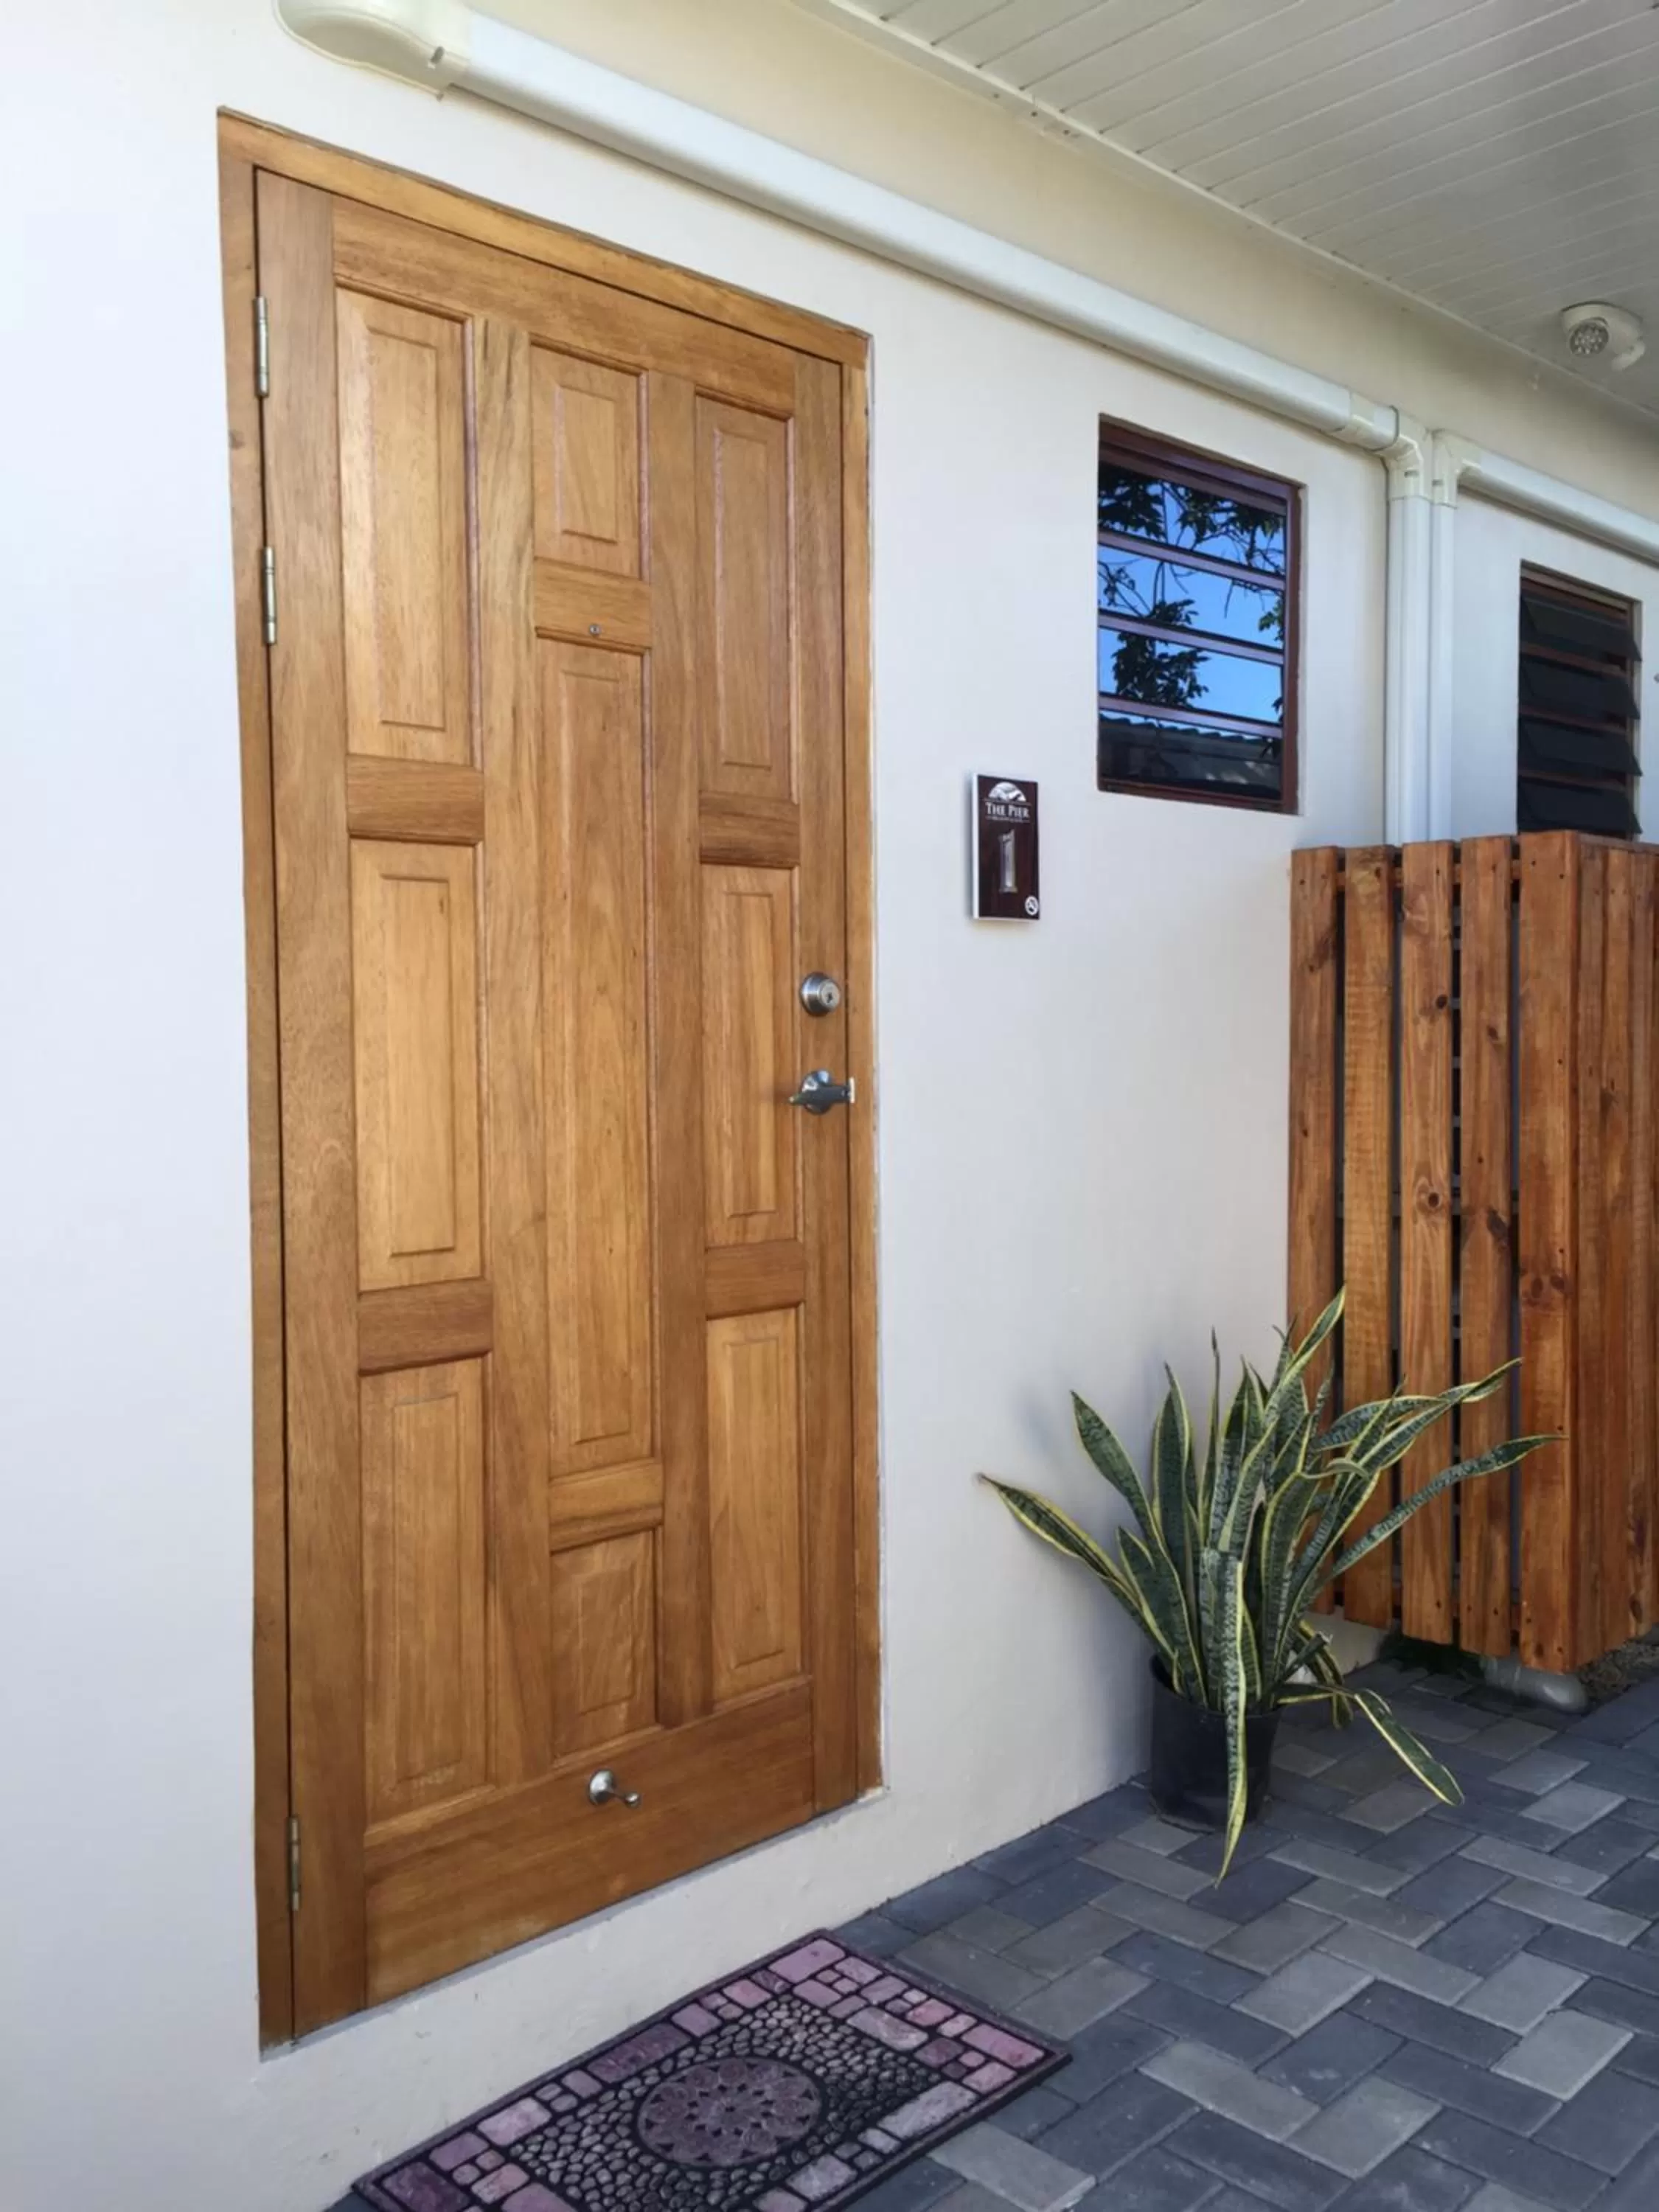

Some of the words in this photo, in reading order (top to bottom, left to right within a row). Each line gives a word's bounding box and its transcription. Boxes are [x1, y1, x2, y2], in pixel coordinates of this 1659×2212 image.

[985, 802, 1006, 815] THE
[1008, 804, 1030, 818] PIER
[998, 828, 1018, 894] 1
